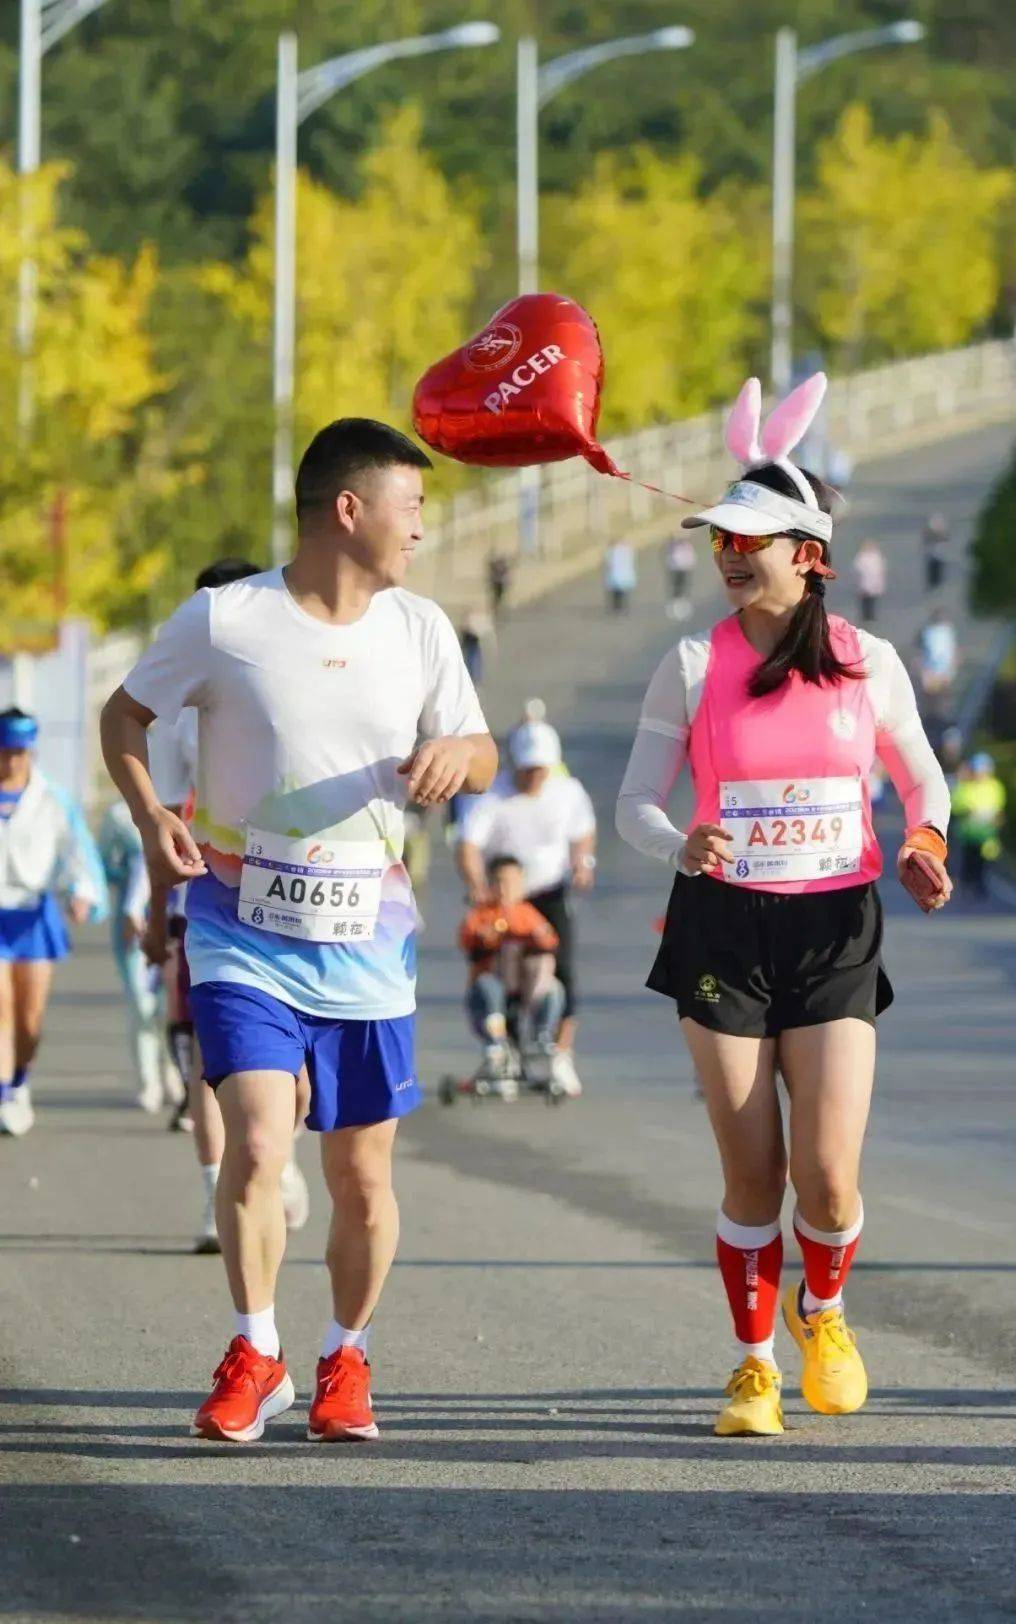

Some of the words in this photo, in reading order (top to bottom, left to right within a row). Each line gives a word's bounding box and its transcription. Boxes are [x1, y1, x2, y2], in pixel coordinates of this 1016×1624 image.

[484, 344, 568, 415] PACER
[747, 816, 843, 847] A2349
[266, 874, 360, 908] A0656
